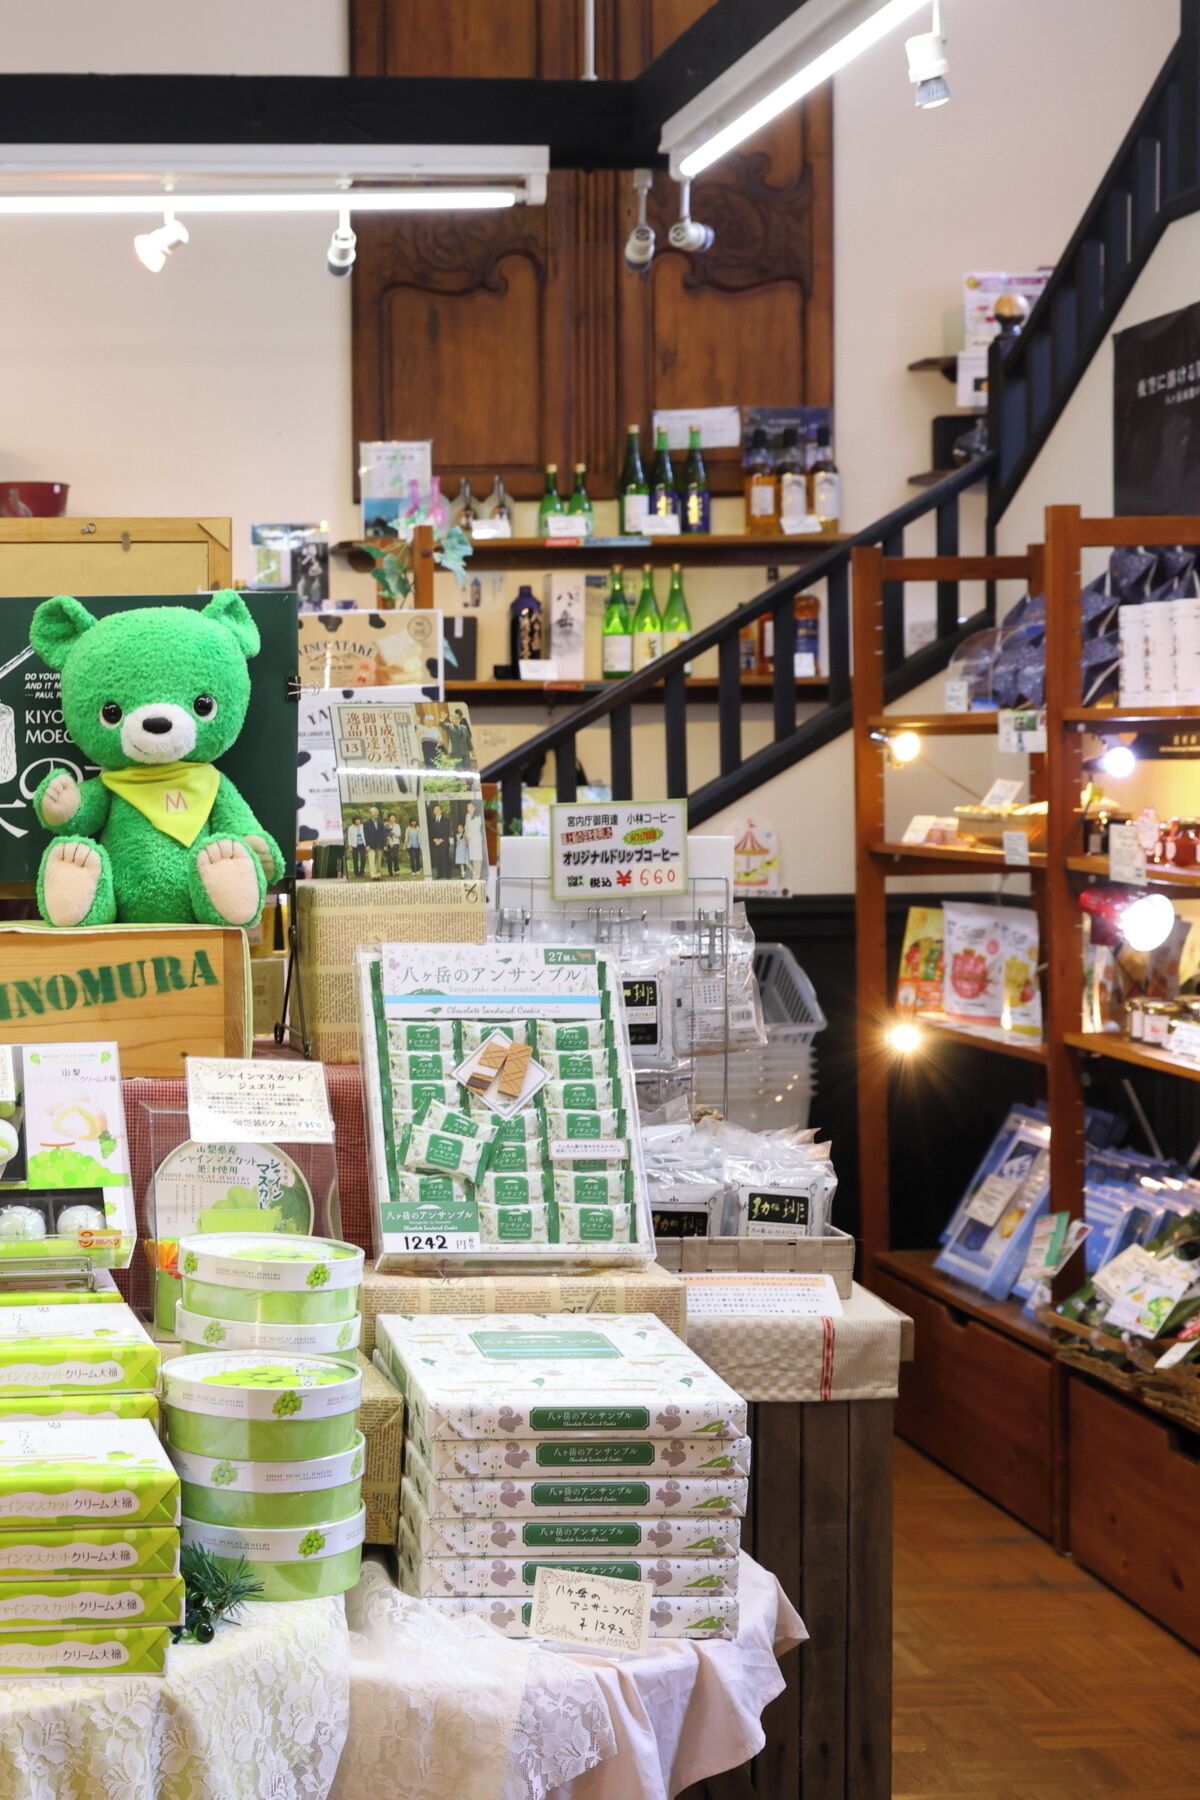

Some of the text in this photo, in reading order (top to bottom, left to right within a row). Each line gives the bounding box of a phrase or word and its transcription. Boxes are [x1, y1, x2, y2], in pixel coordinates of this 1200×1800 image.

[24, 672, 61, 681] DO YOUR
[25, 682, 41, 690] AND
[44, 682, 52, 690] IT
[35, 691, 55, 699] PAUL
[25, 710, 64, 724] KIYO
[25, 729, 75, 744] MOEG
[165, 791, 188, 812] M
[626, 812, 676, 825] 小林コーヒー
[563, 848, 680, 866] オリジナルドリップコーヒー
[401, 966, 583, 984] 八ヶ岳のアンサンブル
[447, 1006, 541, 1014] Chocolate Sandwich Cookie
[217, 1071, 304, 1082] シャインマスカット
[239, 1082, 286, 1090] ジュエリー
[386, 1210, 473, 1220] 八ヶ岳のアンサンブル
[404, 1235, 448, 1250] 1242
[548, 1411, 633, 1421] 八ヶ岳のアンサンブル
[553, 1447, 638, 1457] 八ヶ岳のアンサンブル
[549, 1487, 633, 1497] 八ヶ岳のアンサンブル
[540, 1527, 624, 1537] 八ヶ岳のアンサンブル
[570, 1601, 635, 1616] アンサンブル
